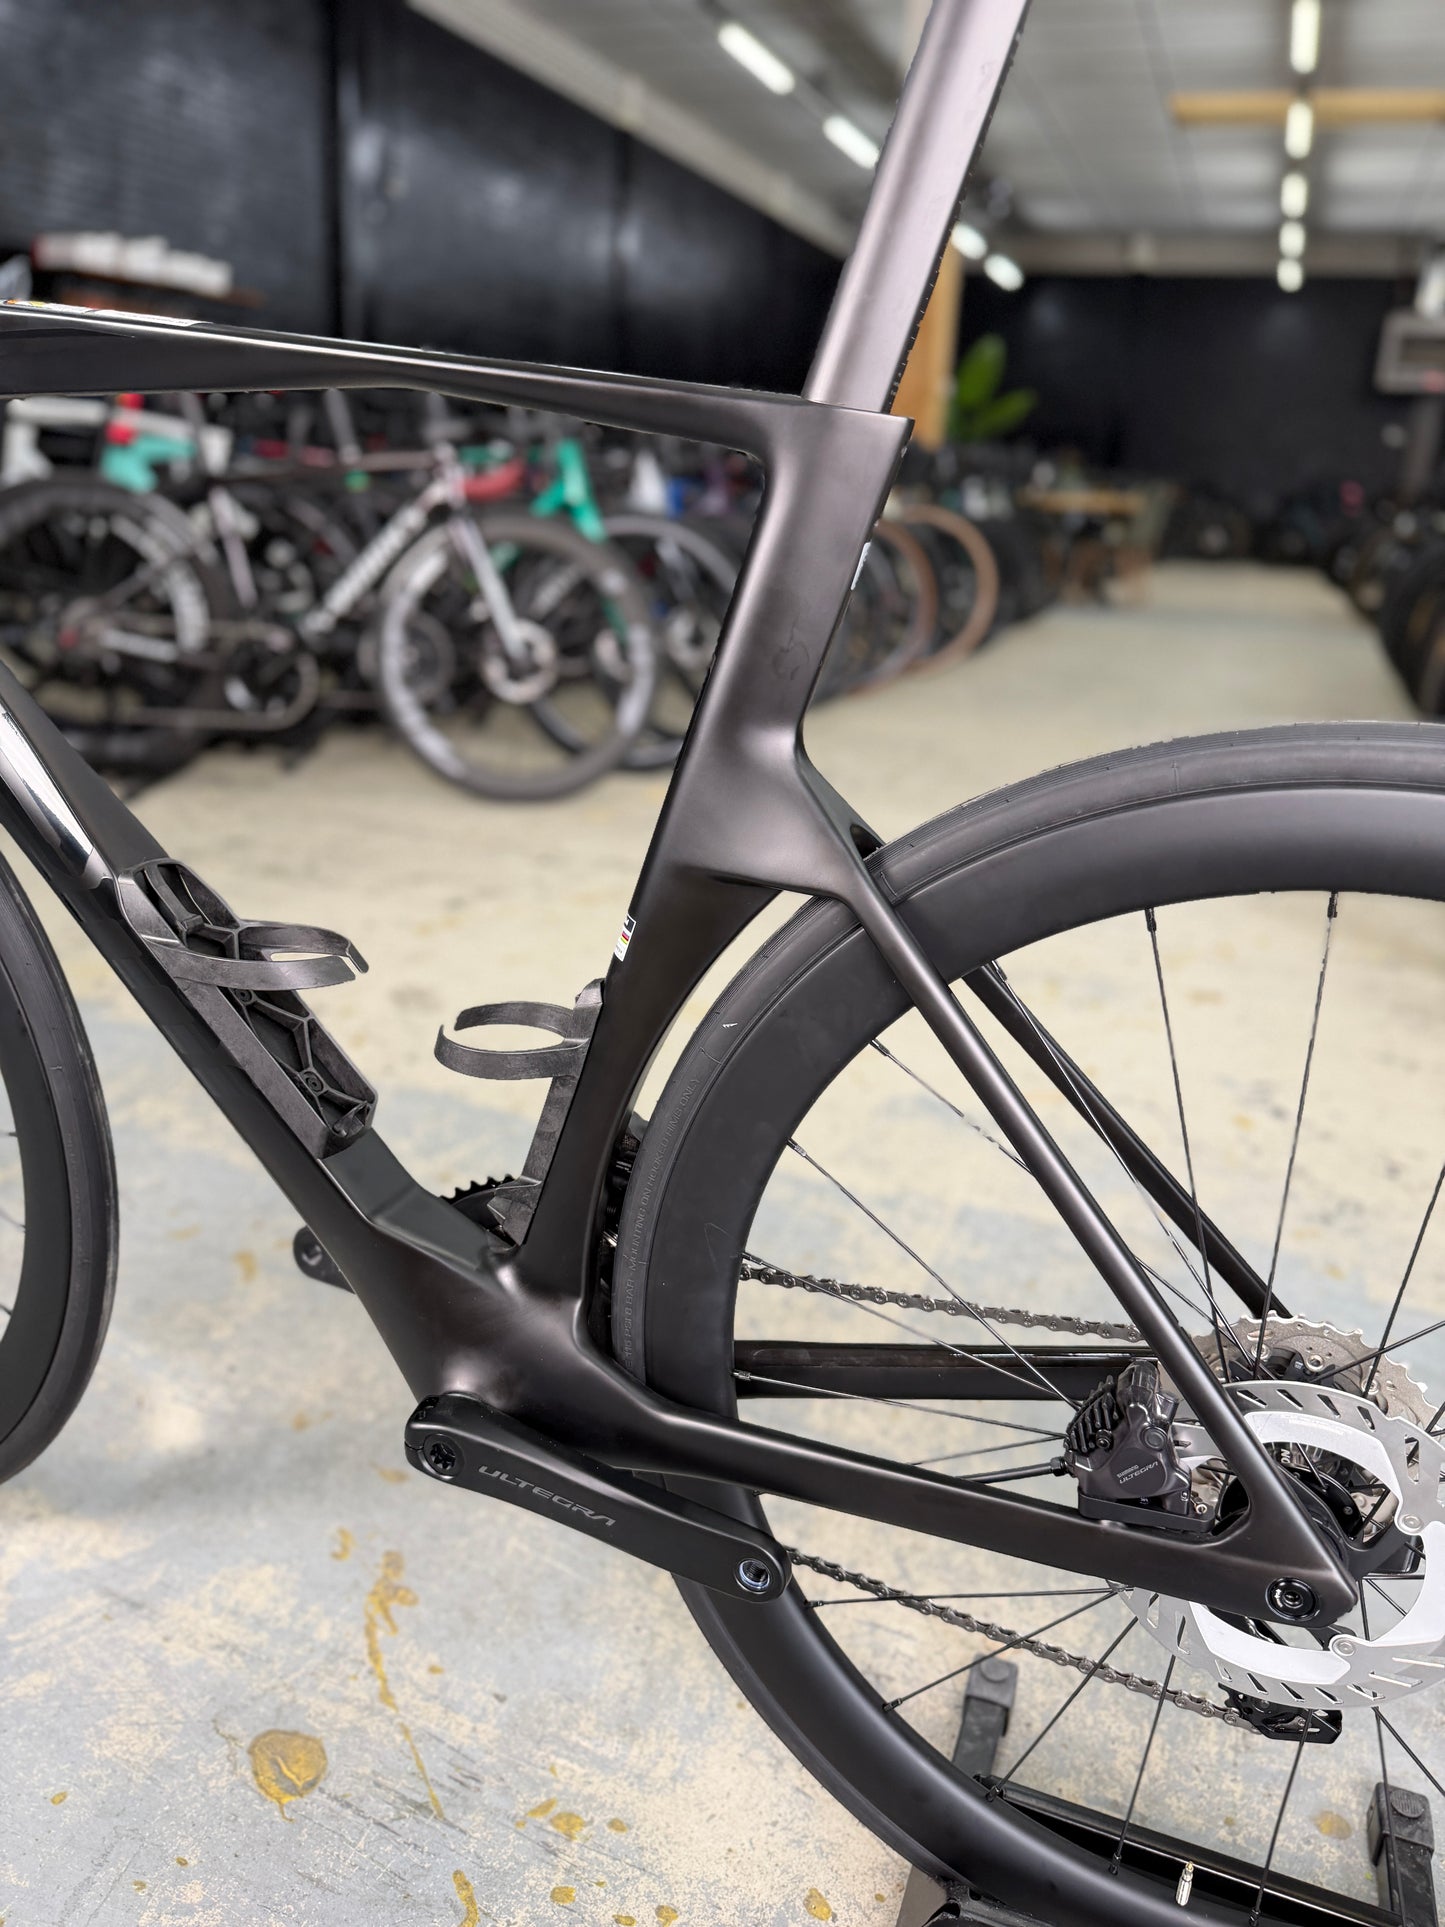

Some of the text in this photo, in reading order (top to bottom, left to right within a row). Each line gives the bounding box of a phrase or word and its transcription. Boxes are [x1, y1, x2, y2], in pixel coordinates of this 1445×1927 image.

[641, 1184, 652, 1206] ON
[680, 1078, 701, 1109] ONLY
[478, 1465, 616, 1527] ULTEGRA
[1119, 1461, 1159, 1484] ULTEGRA
